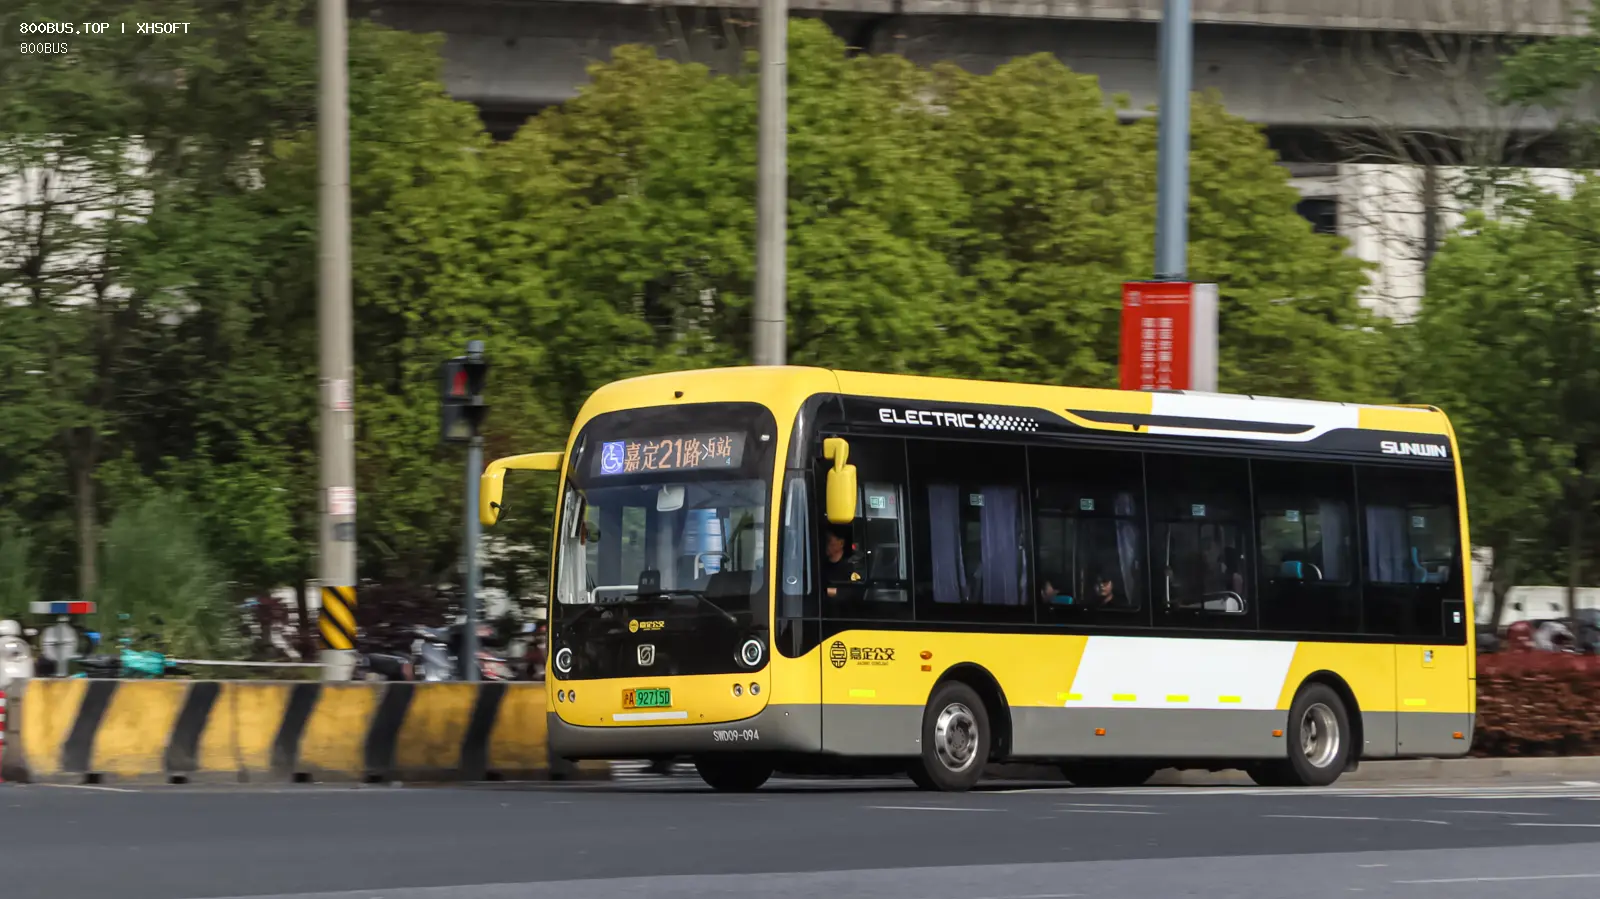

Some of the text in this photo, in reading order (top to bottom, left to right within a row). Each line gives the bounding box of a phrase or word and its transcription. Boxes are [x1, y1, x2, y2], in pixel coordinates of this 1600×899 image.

[878, 408, 976, 429] ELECTRIC
[623, 437, 702, 473] 嘉定21路
[1380, 440, 1447, 458] SUNWIN
[637, 690, 670, 705] 92715D
